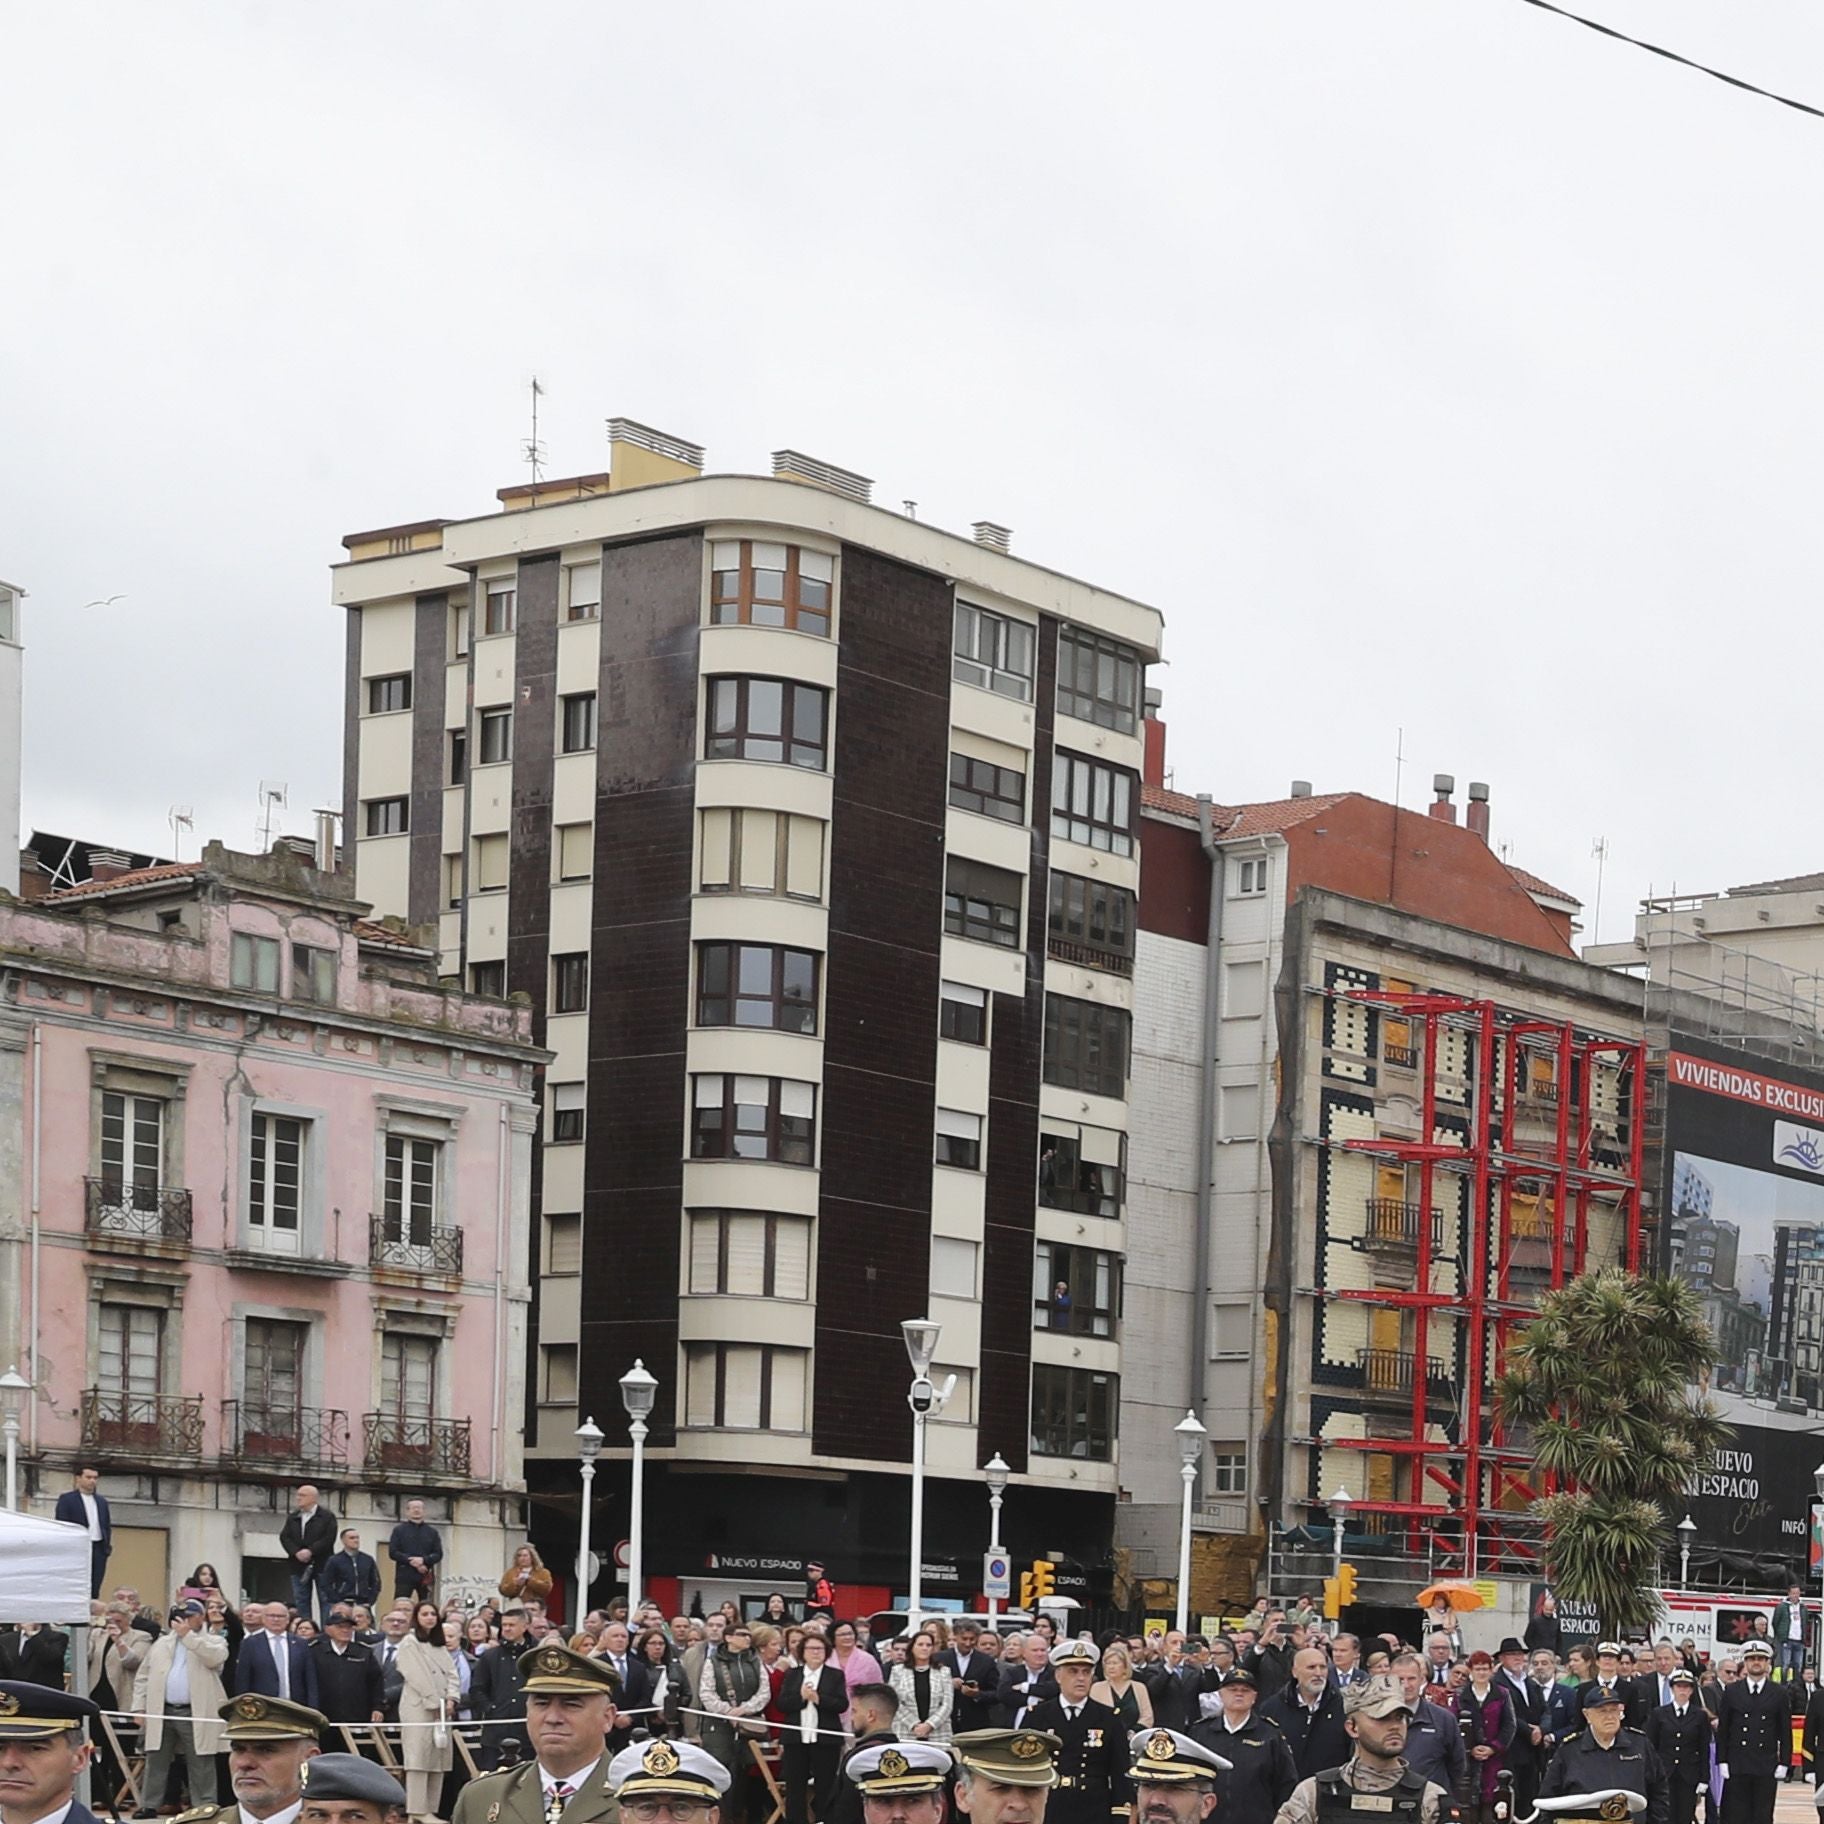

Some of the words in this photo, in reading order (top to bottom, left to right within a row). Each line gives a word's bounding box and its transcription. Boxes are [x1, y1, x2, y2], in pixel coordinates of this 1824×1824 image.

[1675, 1058, 1762, 1101] VIVIENDAS
[1701, 1475, 1759, 1500] ESPACIO
[721, 1556, 757, 1569] NUEVO
[760, 1558, 802, 1571] ESPACIO
[1560, 1617, 1601, 1635] ESPACIO
